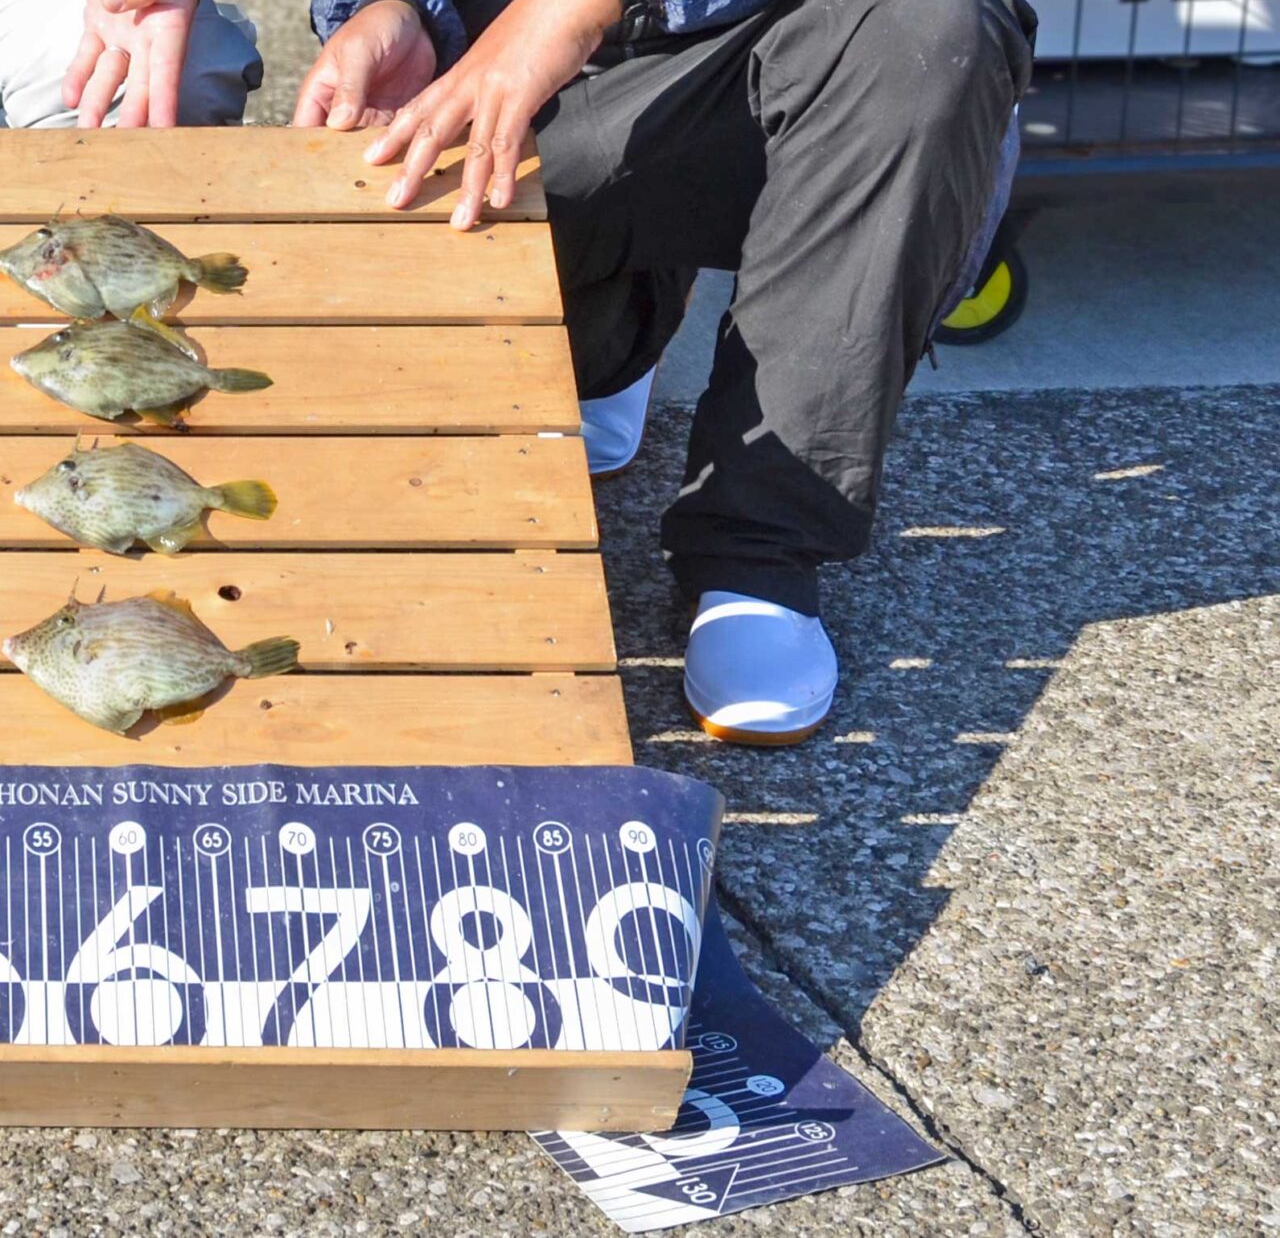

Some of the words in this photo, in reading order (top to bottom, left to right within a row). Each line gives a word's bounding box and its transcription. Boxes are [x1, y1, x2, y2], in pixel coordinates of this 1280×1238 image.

[112, 780, 213, 806] SUNNY
[222, 780, 288, 806] SIDE
[295, 783, 420, 806] MARINA
[32, 830, 53, 847] 55
[201, 831, 222, 847] 65
[288, 831, 308, 847] 70
[371, 830, 392, 847] 75
[458, 831, 478, 846] 80
[542, 830, 563, 847] 85
[628, 830, 648, 846] 90
[65, 886, 209, 1046] 6
[246, 887, 371, 1047] 7
[423, 885, 563, 1049] 8
[705, 1035, 730, 1050] 115
[752, 1077, 778, 1093] 120
[800, 1123, 828, 1139] 125
[675, 1176, 717, 1204] 130
